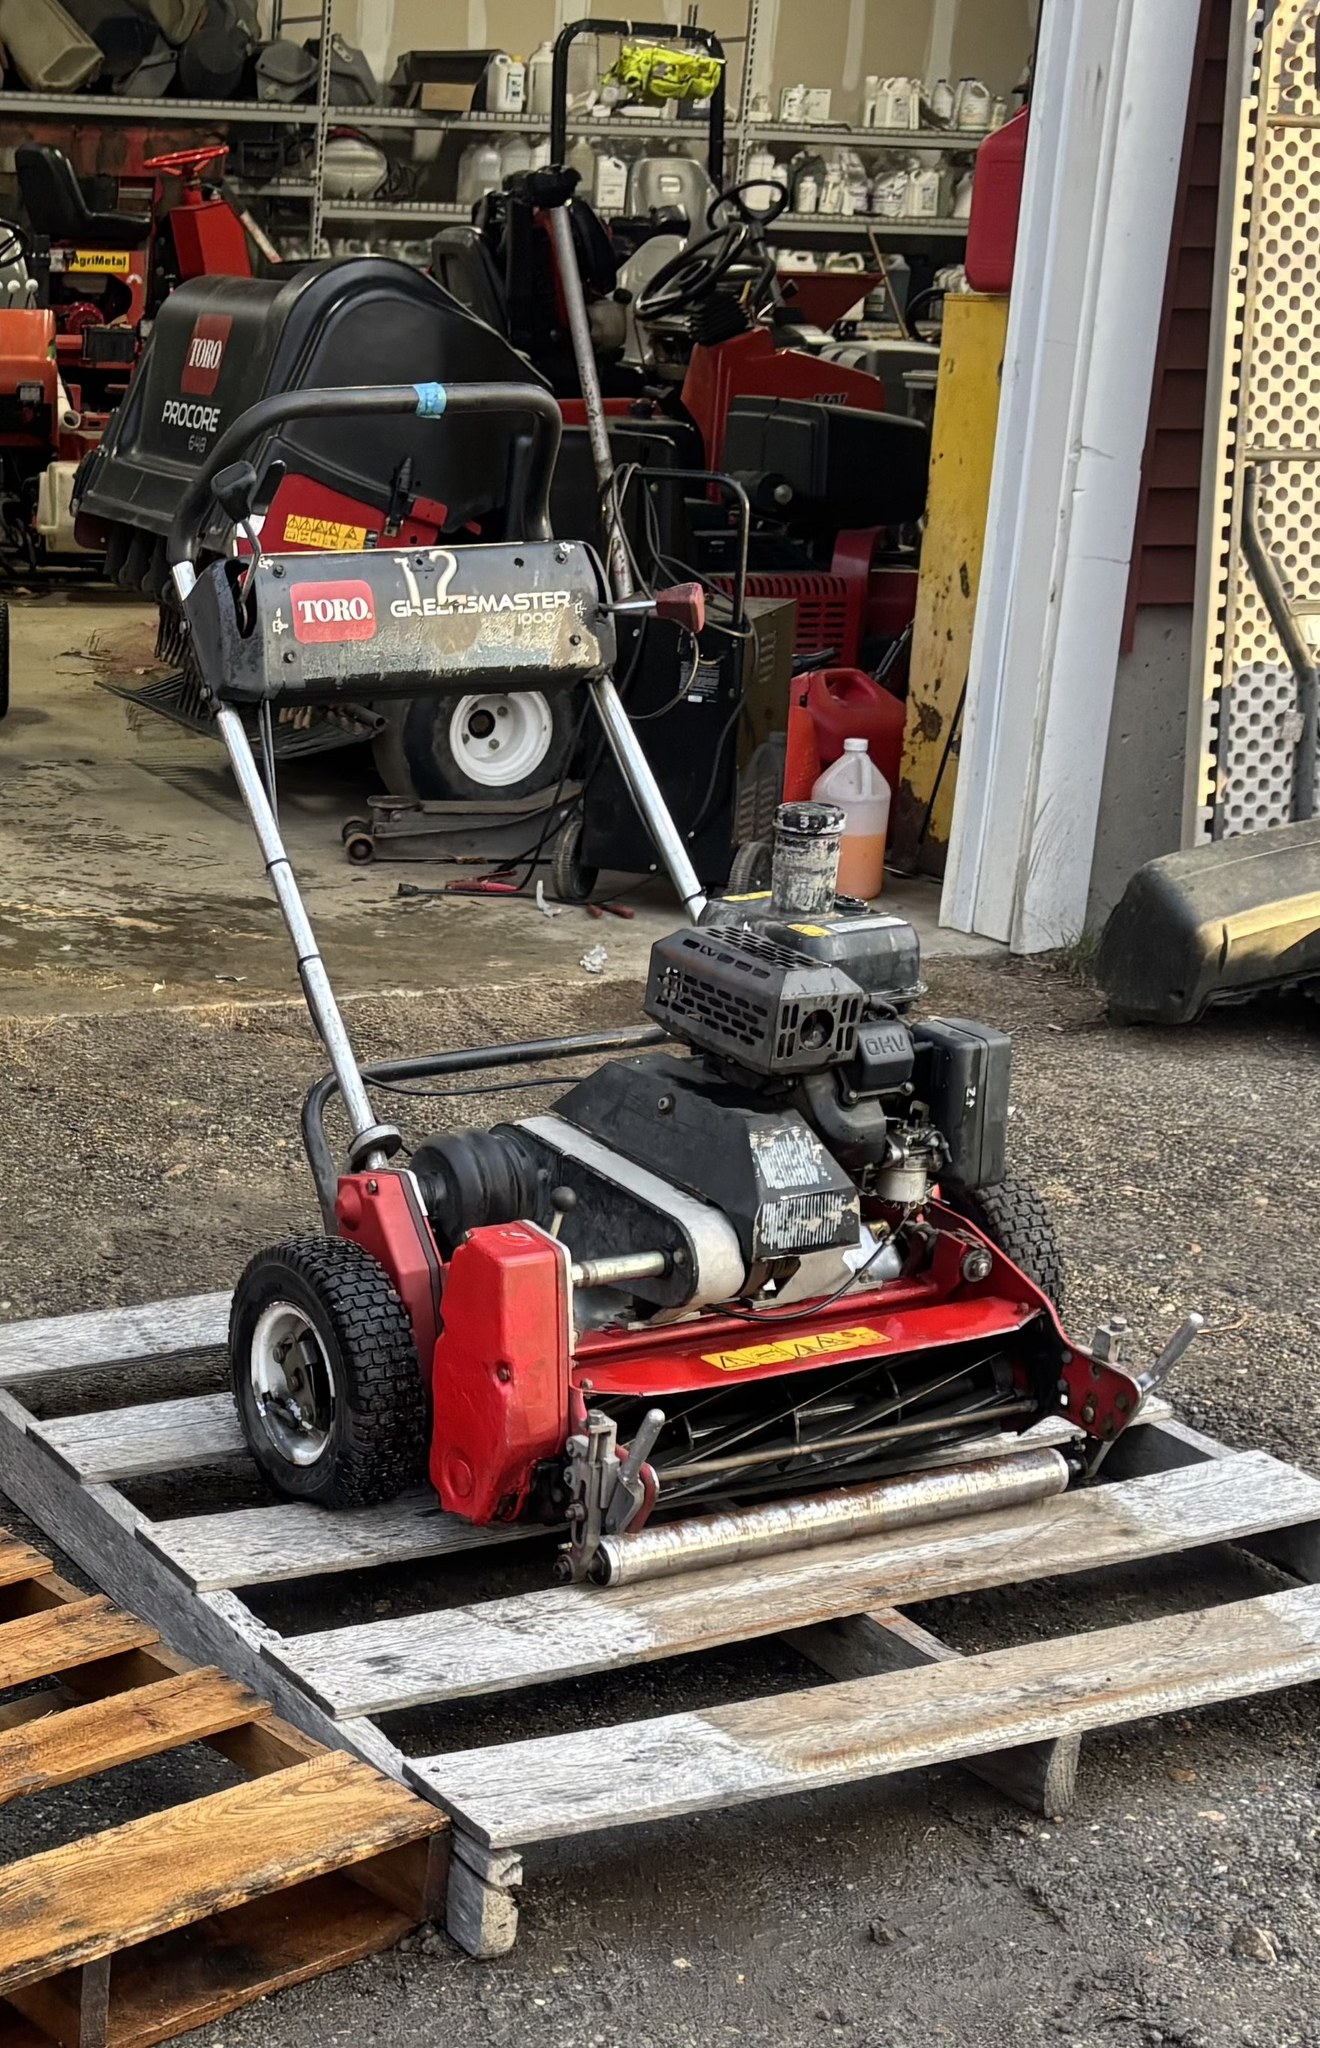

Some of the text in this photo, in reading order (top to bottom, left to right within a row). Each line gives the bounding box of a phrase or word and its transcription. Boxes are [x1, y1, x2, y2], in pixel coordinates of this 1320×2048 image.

[71, 255, 127, 267] AgriMetal
[188, 338, 222, 369] TORO
[161, 400, 221, 432] PROCORE
[297, 596, 373, 624] TORO
[517, 611, 555, 625] 1000
